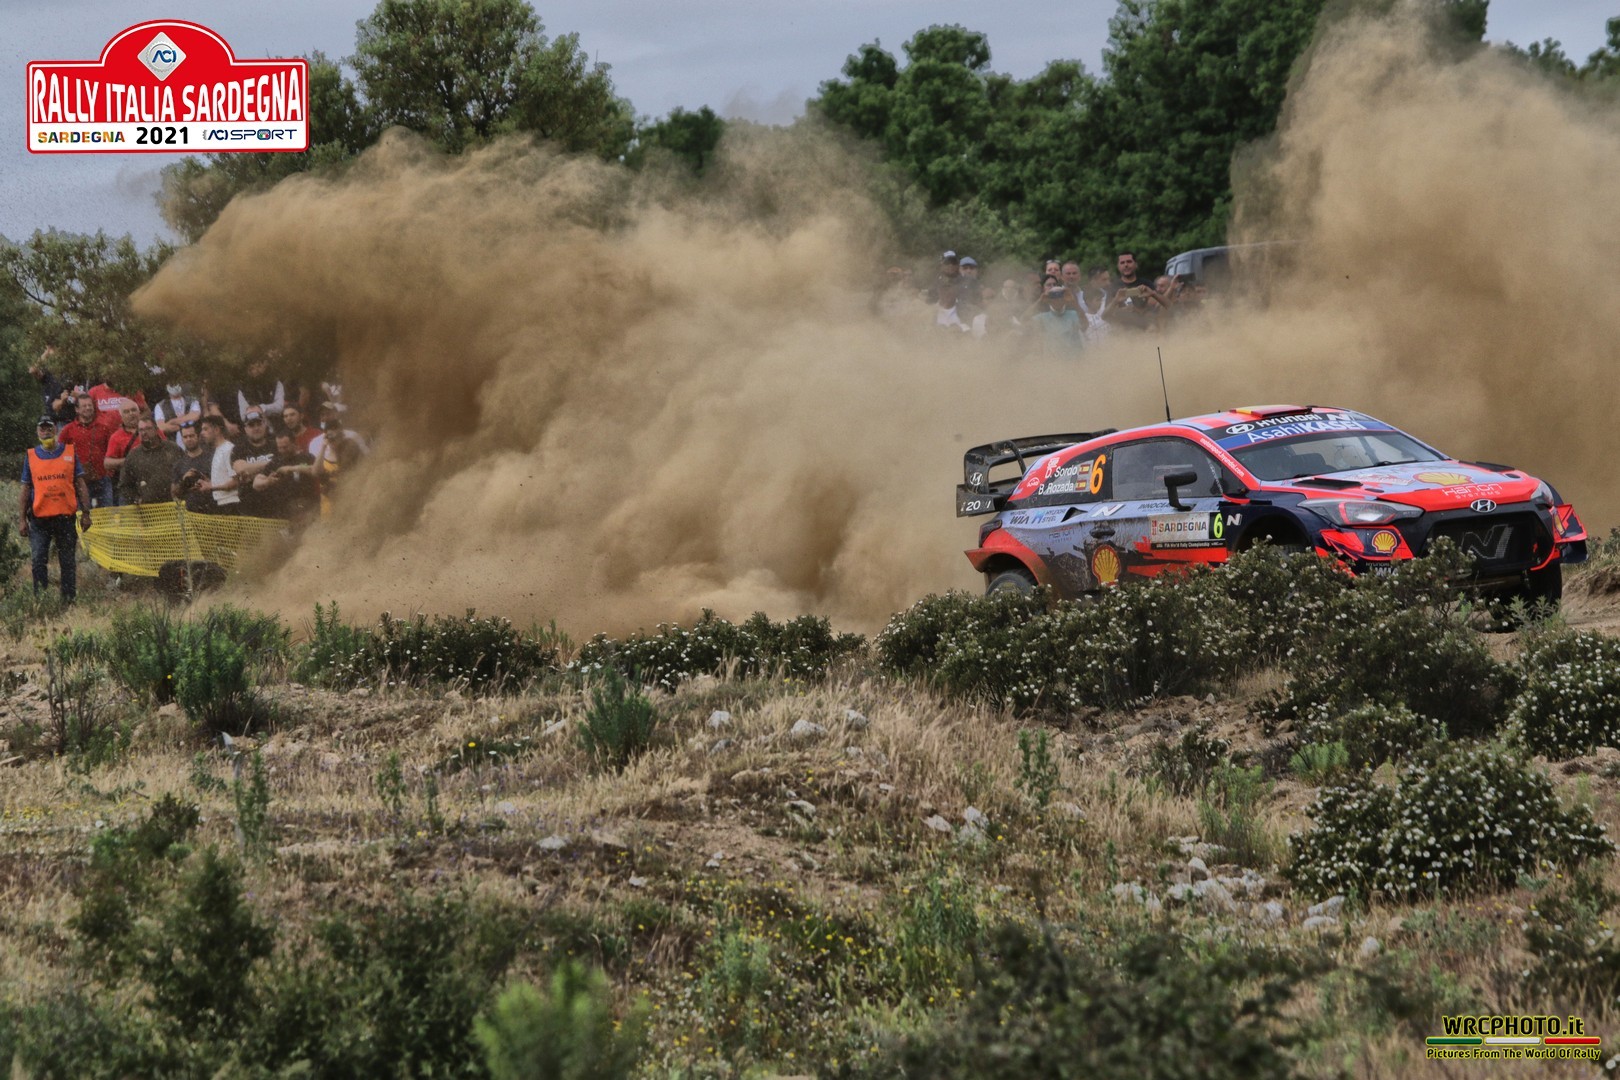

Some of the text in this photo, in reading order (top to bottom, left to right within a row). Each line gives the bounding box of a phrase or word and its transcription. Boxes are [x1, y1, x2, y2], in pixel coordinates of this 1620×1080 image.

[1256, 413, 1322, 427] HYUNDAI
[1045, 465, 1077, 479] D. Sordo
[1089, 454, 1107, 495] 6
[1038, 483, 1046, 495] B.
[1046, 481, 1074, 494] Rozada
[1159, 521, 1207, 532] SARDEGNA
[1213, 513, 1224, 538] 6
